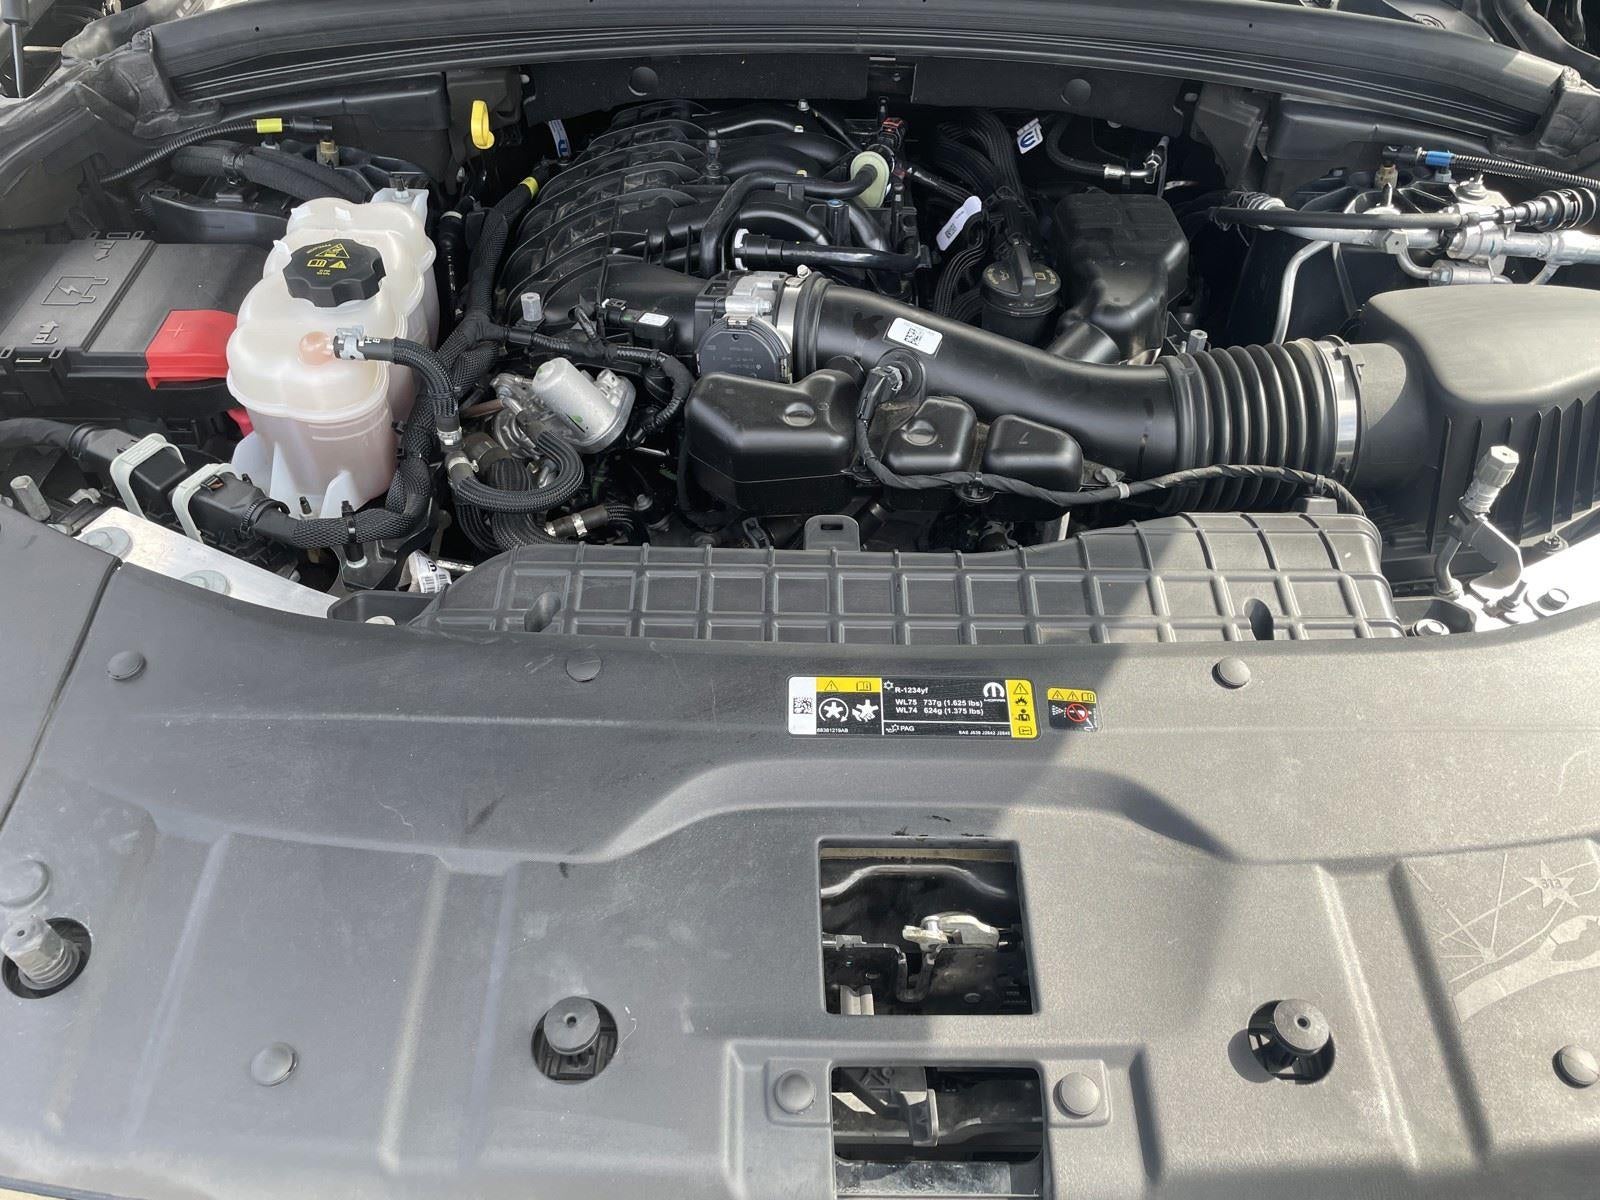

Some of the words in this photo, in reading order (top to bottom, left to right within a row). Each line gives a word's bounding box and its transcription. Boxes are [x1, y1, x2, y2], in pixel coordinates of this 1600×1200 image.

[895, 687, 928, 695] R-1234yf
[923, 699, 942, 707] 737g
[943, 699, 967, 707] (1.625
[968, 699, 983, 708] lbs)
[923, 707, 942, 715] 624g
[944, 708, 967, 716] (1.375
[969, 708, 984, 716] lbs)
